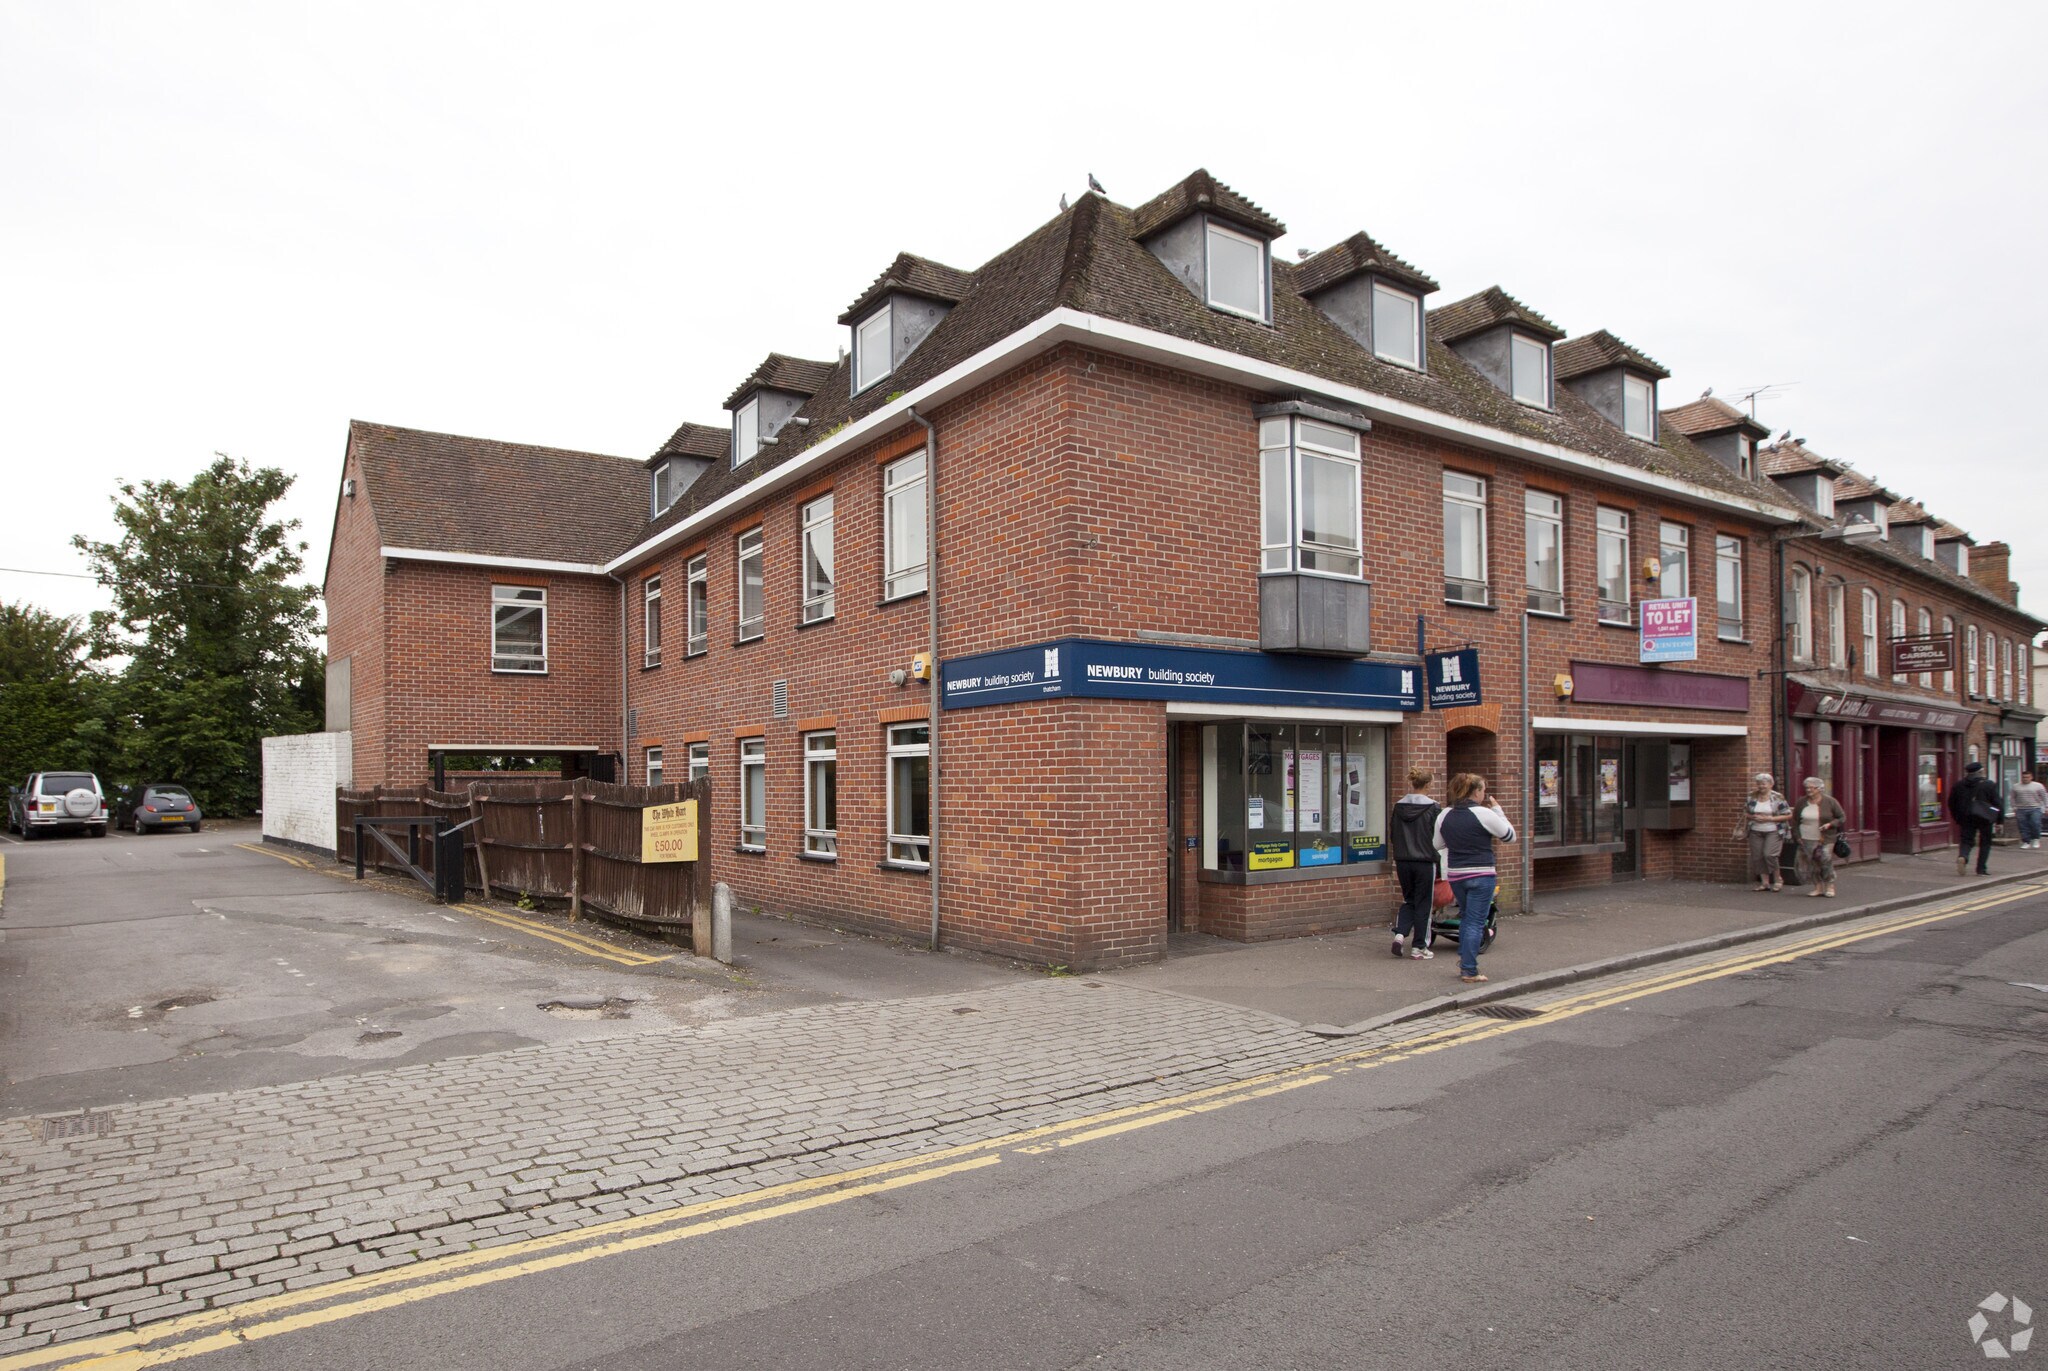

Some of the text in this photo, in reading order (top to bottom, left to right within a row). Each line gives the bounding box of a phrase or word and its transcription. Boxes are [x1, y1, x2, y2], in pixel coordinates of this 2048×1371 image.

[1648, 601, 1688, 611] RETAIL UNIT
[1646, 609, 1691, 625] TO LET
[1900, 651, 1946, 660] CARROLL
[1087, 664, 1215, 685] NEWBURY building society
[947, 671, 1035, 691] NEWBURY building society
[1043, 685, 1061, 693] thatcham
[1436, 683, 1471, 693] NEWBURY
[1431, 692, 1477, 702] building society
[1284, 753, 1320, 762] MOGAGES
[652, 809, 661, 820] The
[675, 806, 687, 817] Hart
[655, 839, 683, 852] £50.00
